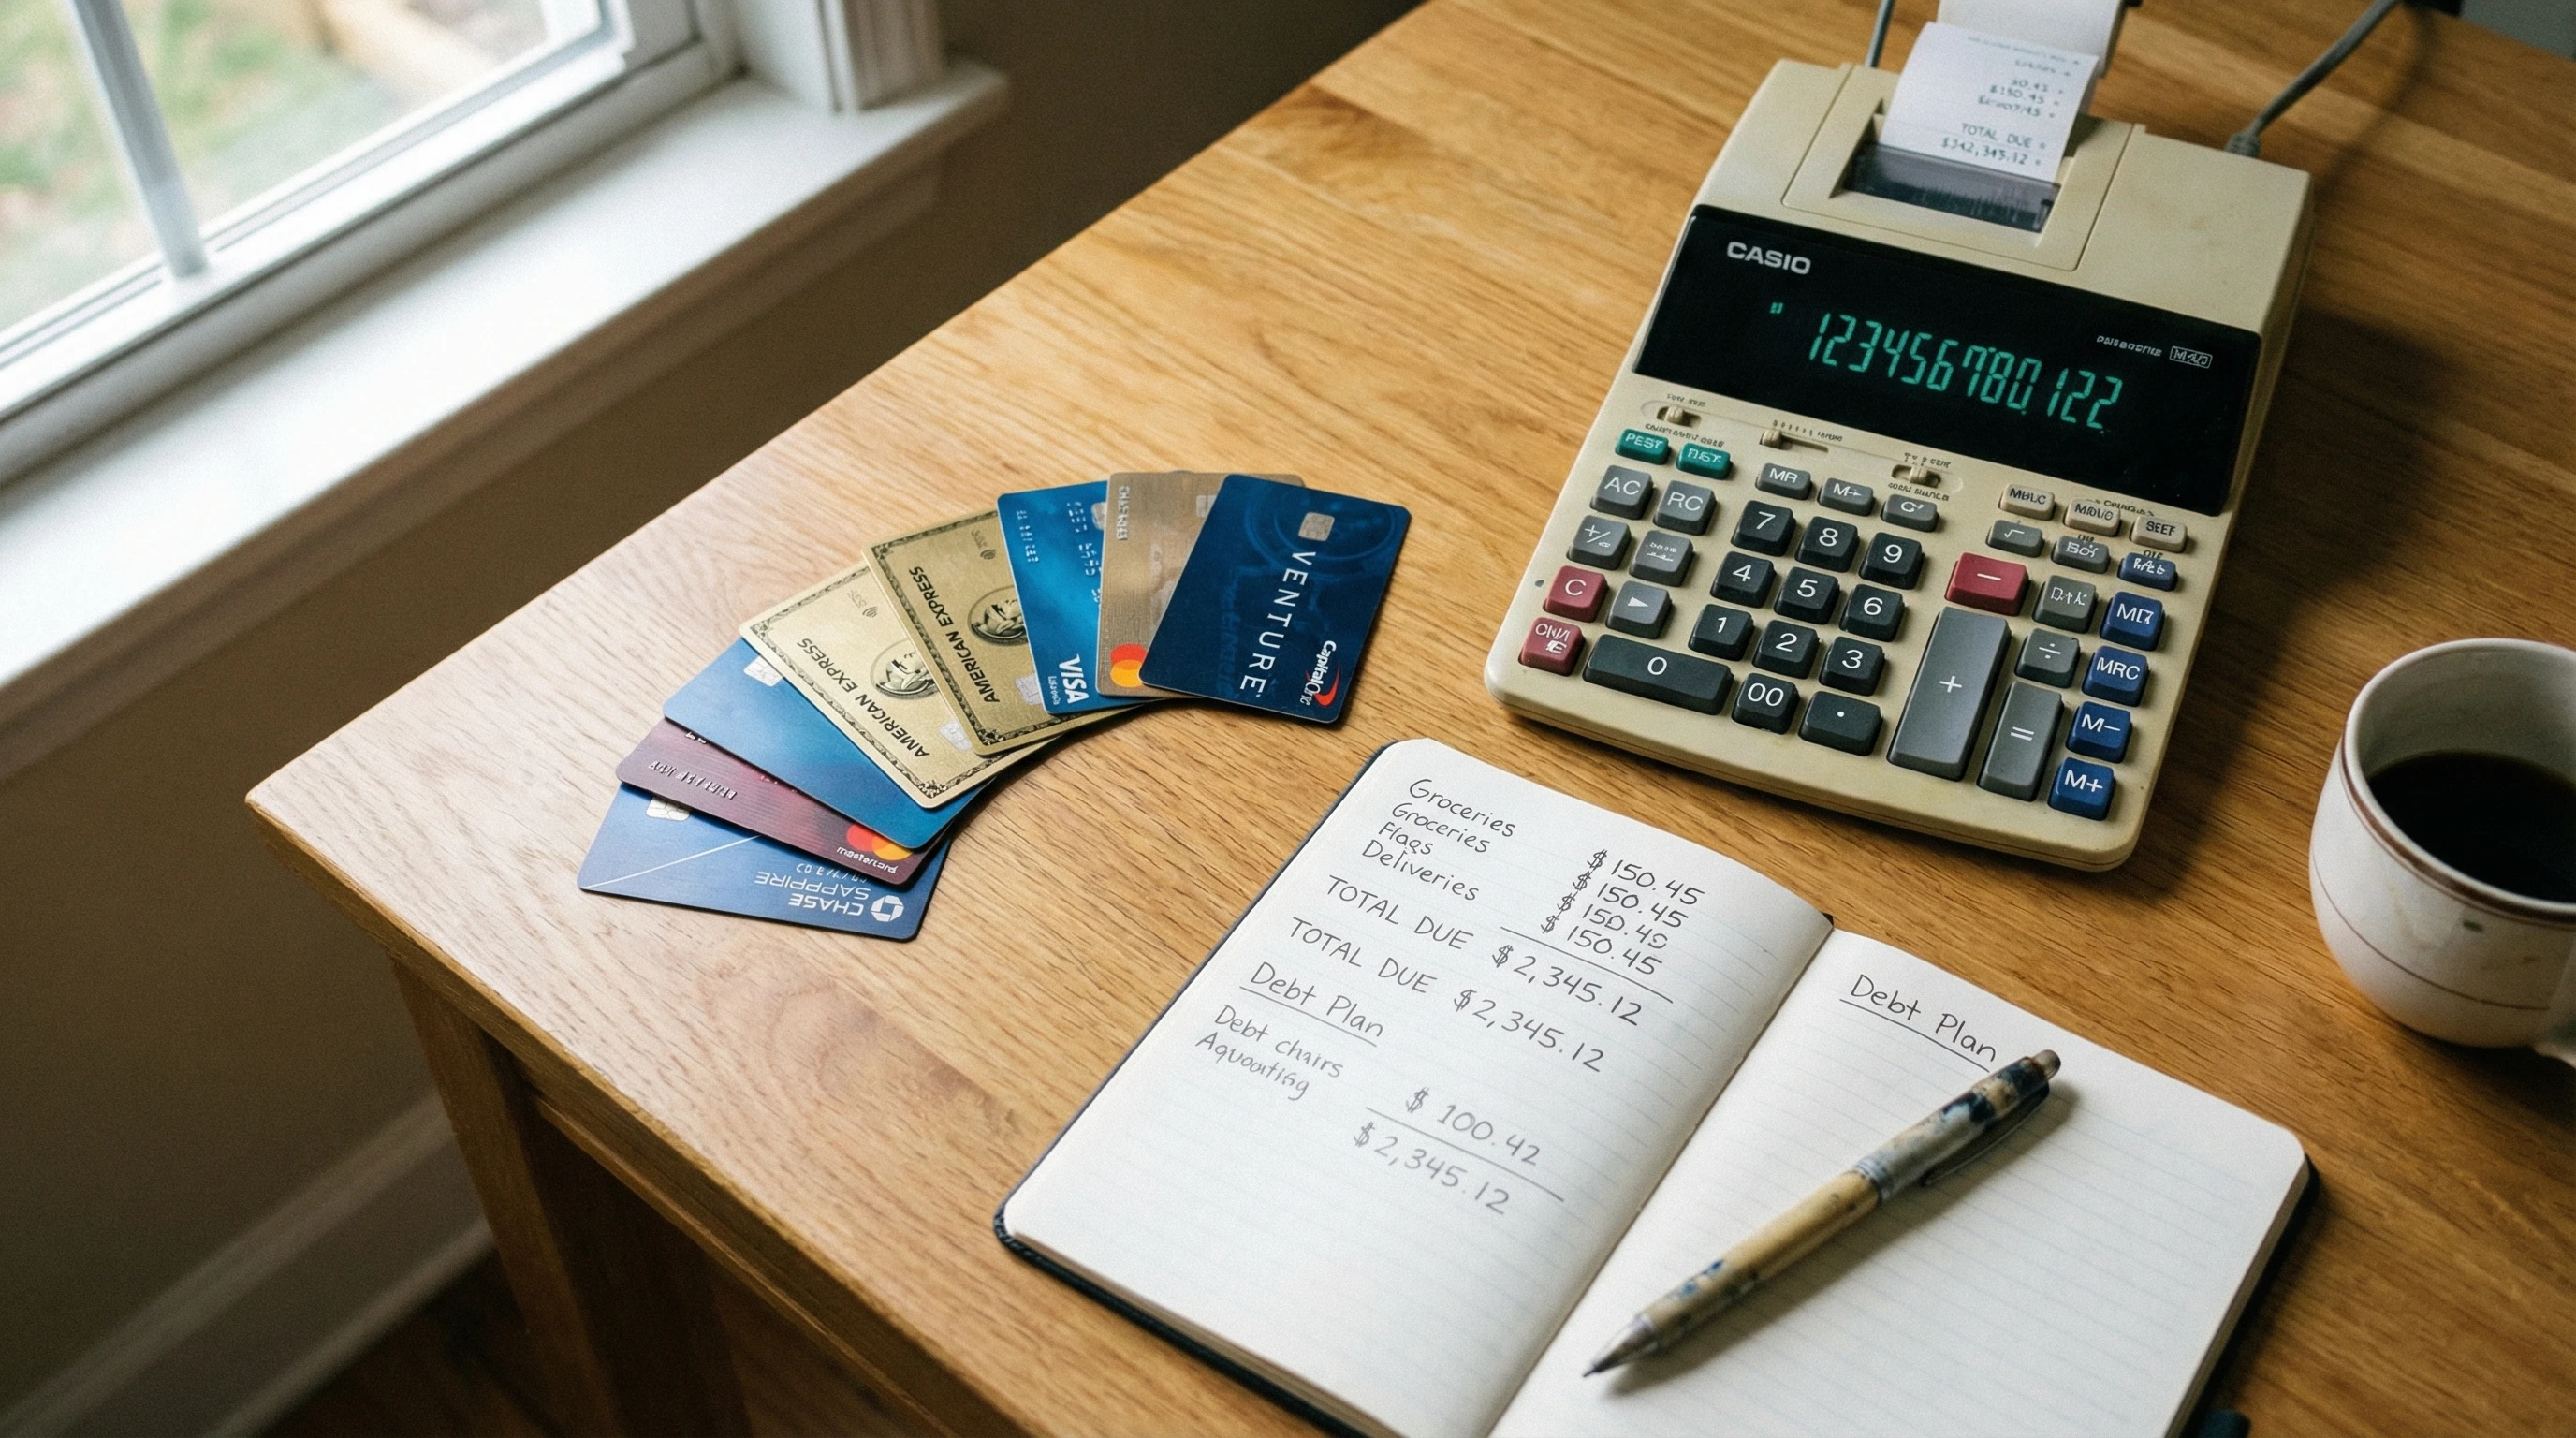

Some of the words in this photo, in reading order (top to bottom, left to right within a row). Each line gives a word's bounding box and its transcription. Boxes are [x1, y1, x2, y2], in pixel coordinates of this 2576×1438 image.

[1962, 123, 1998, 141] TOTAL
[1727, 242, 1811, 275] CASIO
[1604, 477, 1641, 496] AC
[1667, 492, 1704, 511] RC
[1758, 511, 1777, 530] 7
[1819, 527, 1838, 547] 8
[1882, 544, 1903, 563] 9
[1733, 565, 1751, 582] 4
[909, 565, 954, 627] EXPRESS
[1565, 579, 1587, 596] C
[1796, 579, 1818, 597] 5
[1863, 597, 1883, 616] 6
[1717, 616, 1727, 634] 1
[1775, 633, 1797, 653] 2
[797, 638, 858, 693] EXPRESS
[945, 630, 1001, 703] AMERICAN
[1647, 656, 1668, 676] 0
[1841, 650, 1864, 669] 3
[2096, 657, 2141, 681] MRC
[1059, 653, 1090, 704] VISA
[1747, 682, 1784, 707] 00
[855, 694, 930, 757] AMERICAN
[2064, 770, 2103, 793] M+
[1409, 778, 1515, 838] Groceries
[1392, 802, 1491, 854] Groceries
[1362, 839, 1480, 901] Deliveries
[788, 892, 865, 917] CHASE
[1327, 875, 1399, 926] TOTAL
[1413, 916, 1474, 950] DUE
[1291, 917, 1362, 968] TOTAL
[1378, 957, 1438, 994] DUE
[1250, 961, 1317, 1008] Debt
[1326, 994, 1383, 1038] Plan
[1214, 1004, 1269, 1042] Debt
[1850, 973, 1922, 1022] Debt
[1934, 1012, 1998, 1064] Plan
[1354, 1121, 1511, 1215] $2,345.12
